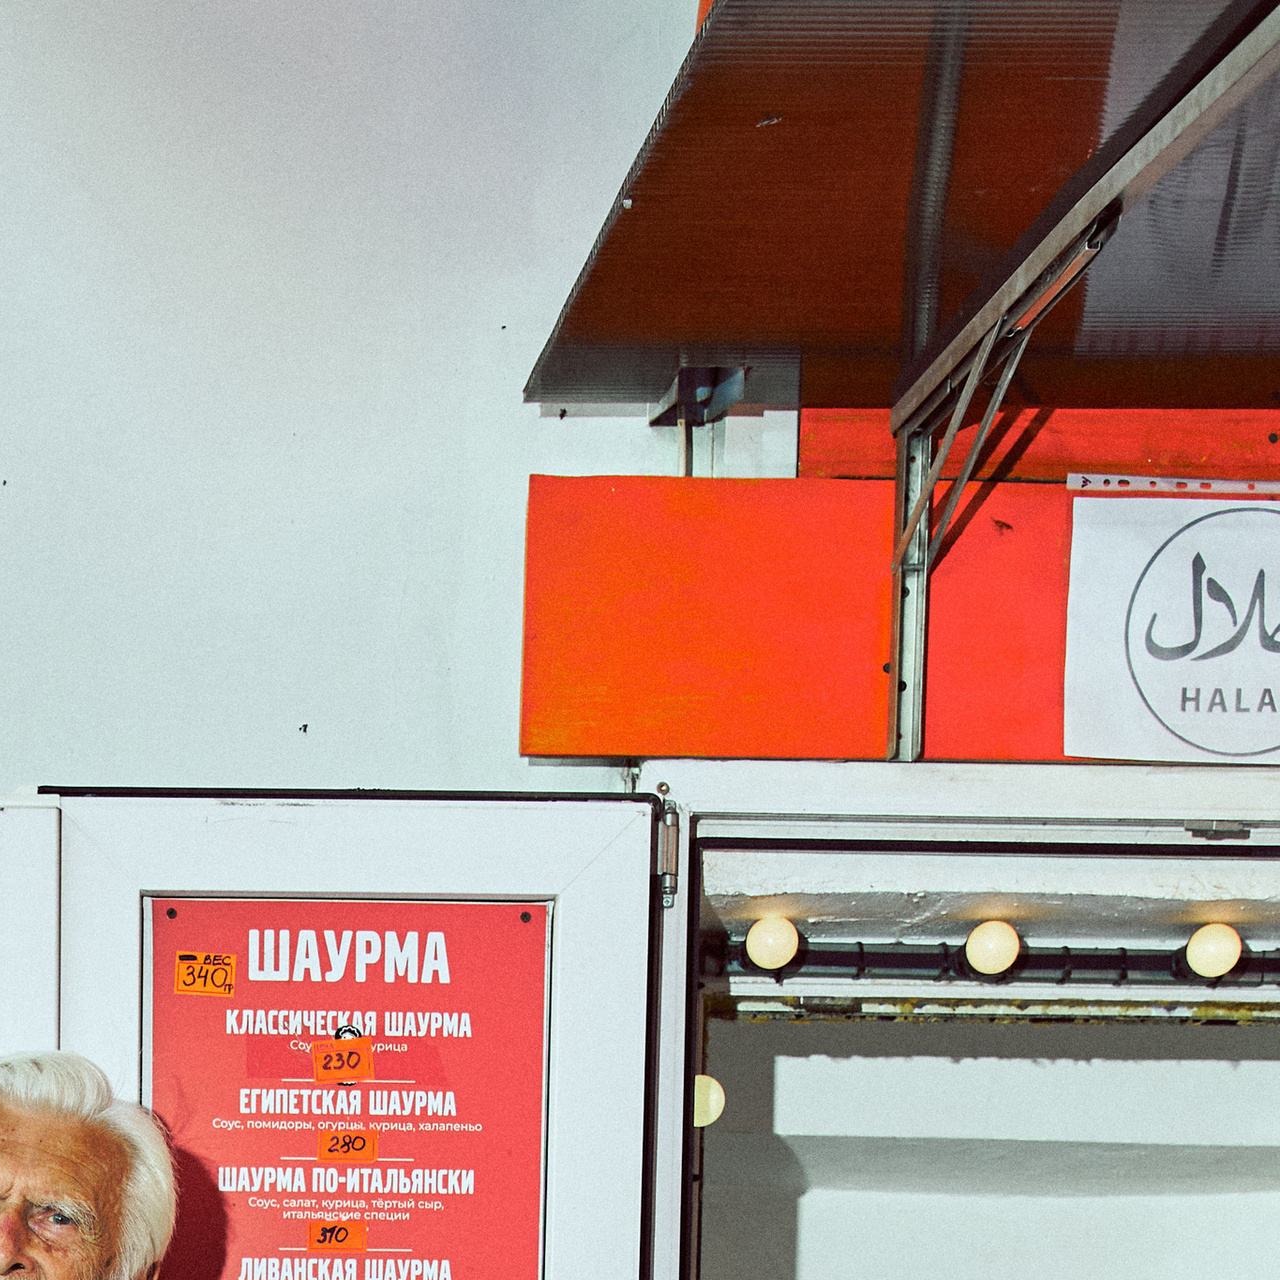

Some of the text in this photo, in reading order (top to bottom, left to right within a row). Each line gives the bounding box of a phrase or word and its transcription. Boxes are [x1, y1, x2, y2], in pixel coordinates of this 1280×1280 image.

[1145, 551, 1280, 661] لال
[1180, 686, 1277, 713] HALA
[203, 954, 232, 966] ВЕС
[248, 929, 451, 984] ШАУРМА
[183, 965, 228, 988] 340
[226, 1009, 473, 1037] КЛАССИЧЕСКАЯ ШАУРМА
[290, 1040, 408, 1053] Соу урица
[322, 1051, 362, 1071] 230
[239, 1088, 457, 1117] ЕГИПЕТСКАЯ ШАУРМА
[212, 1118, 245, 1131] Соус,
[247, 1120, 315, 1132] помидоры,
[369, 1121, 415, 1132] курица,
[418, 1121, 483, 1132] халапеньо
[327, 1134, 367, 1153] 280
[218, 1167, 475, 1195] ШАУРМА ПО-ИТАЛЬЯНСКИ
[248, 1197, 445, 1212] Соус, салат, курица, тёртый сыр,
[282, 1212, 410, 1222] итальянские специи
